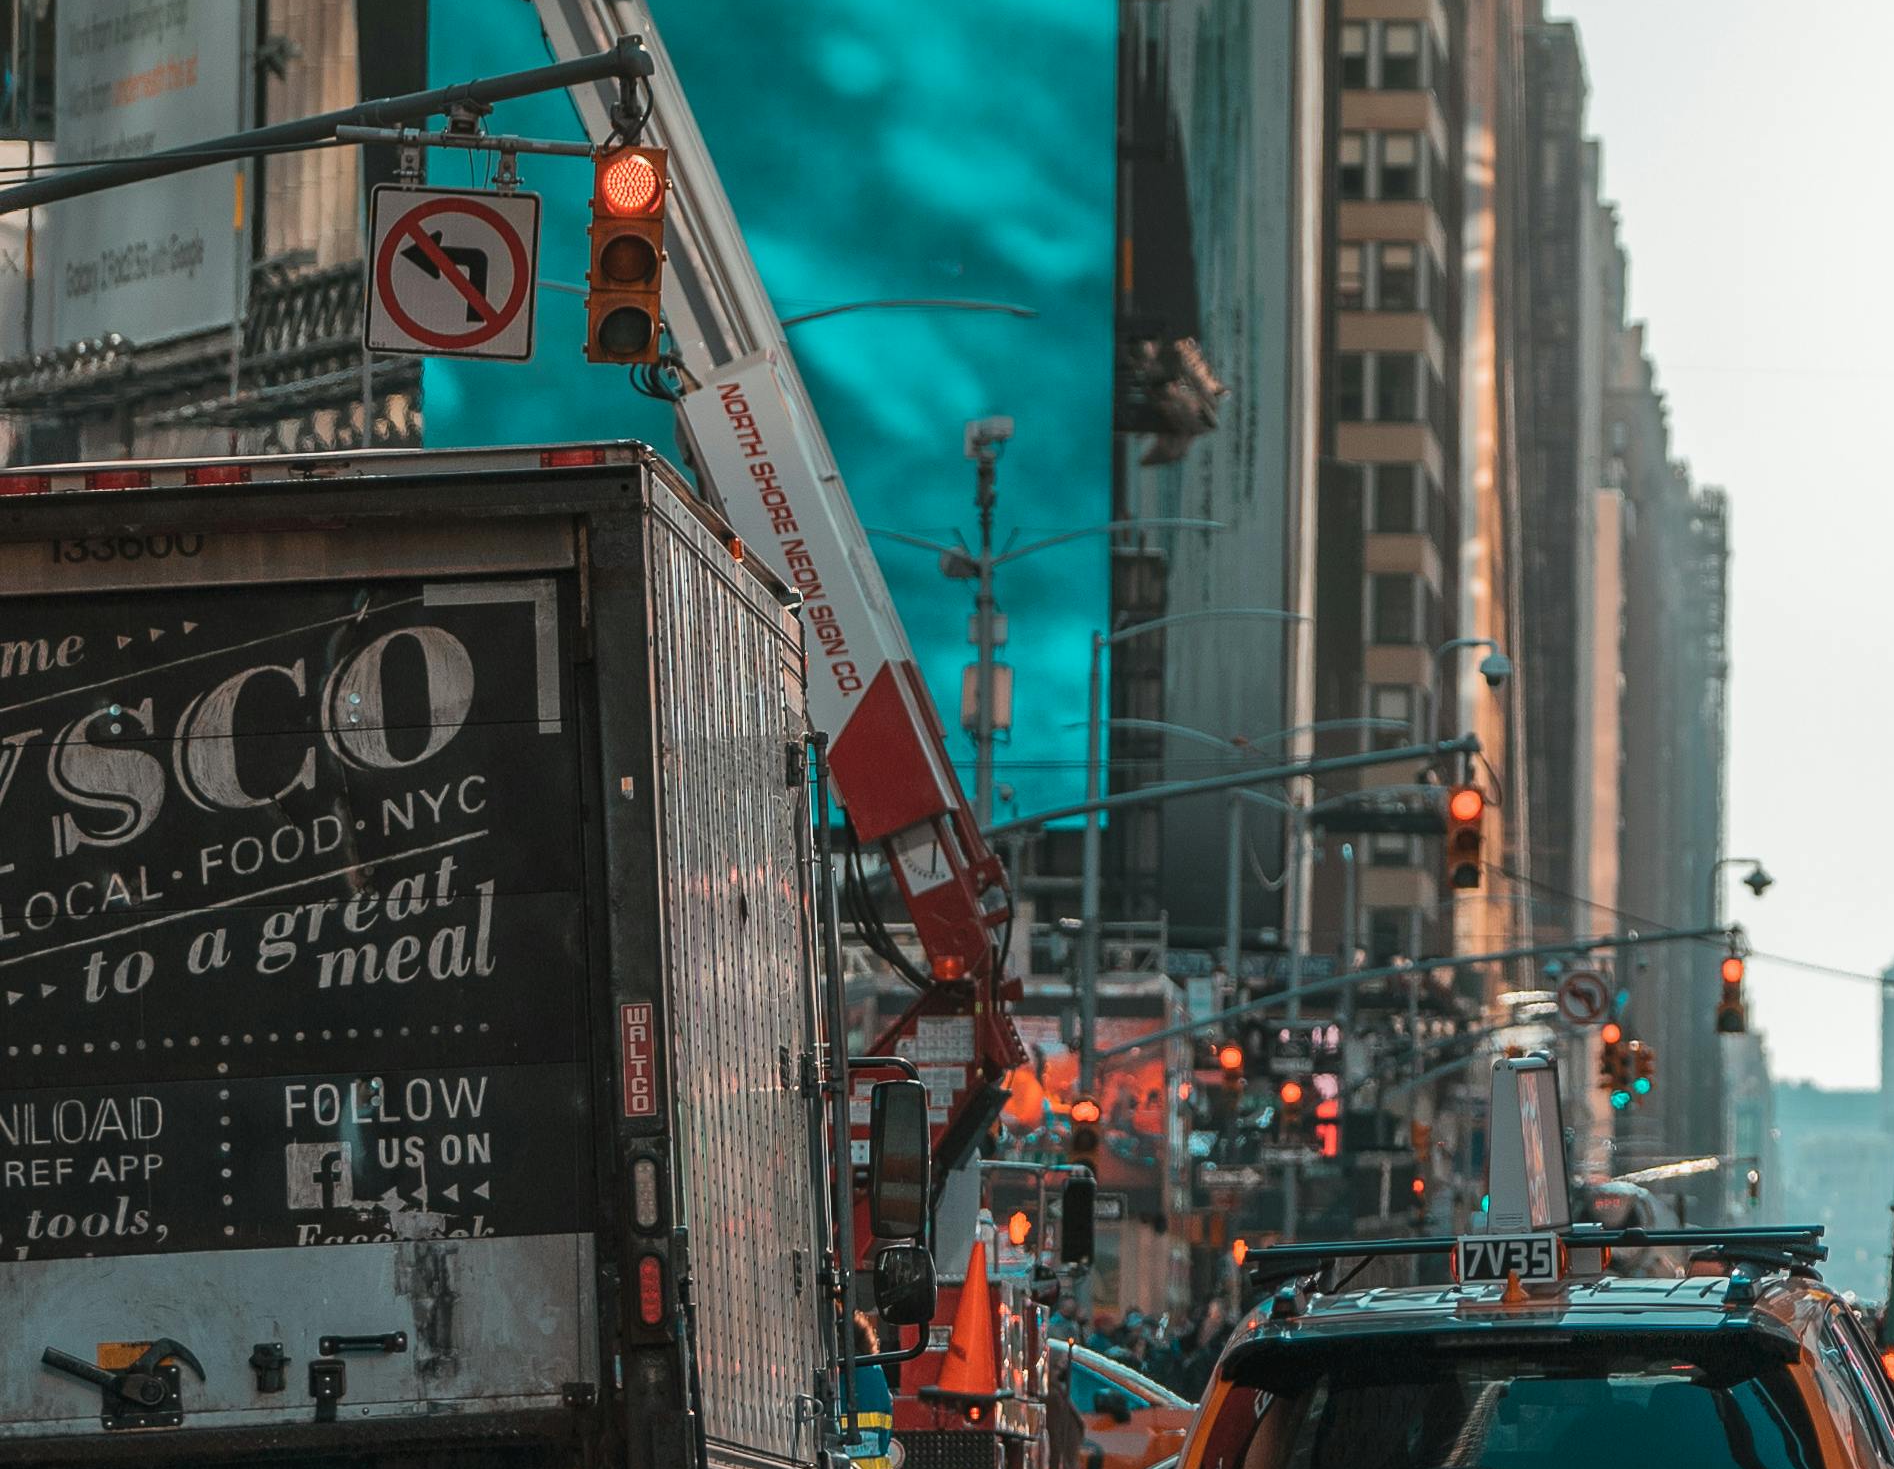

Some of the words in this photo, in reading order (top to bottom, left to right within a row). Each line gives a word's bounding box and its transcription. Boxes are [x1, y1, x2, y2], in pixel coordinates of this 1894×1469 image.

[716, 382, 768, 459] NORTH
[750, 460, 799, 535] SHORE
[780, 538, 827, 602] NEON
[808, 602, 849, 658] SIGN
[831, 660, 863, 697] CO.
[0, 867, 164, 941] LOCAL
[200, 814, 343, 886] FOOD
[382, 774, 488, 837] NYC
[83, 950, 154, 1003] to
[187, 928, 231, 975] a
[256, 857, 458, 975] great
[316, 879, 497, 989] meal
[625, 1007, 653, 1113] WALTCO
[284, 1076, 488, 1129] FOLLOW
[89, 1154, 164, 1184] APP
[378, 1135, 424, 1169] US
[441, 1132, 491, 1165] ON
[27, 1196, 169, 1242] tools,
[1466, 1240, 1551, 1278] 7V35
